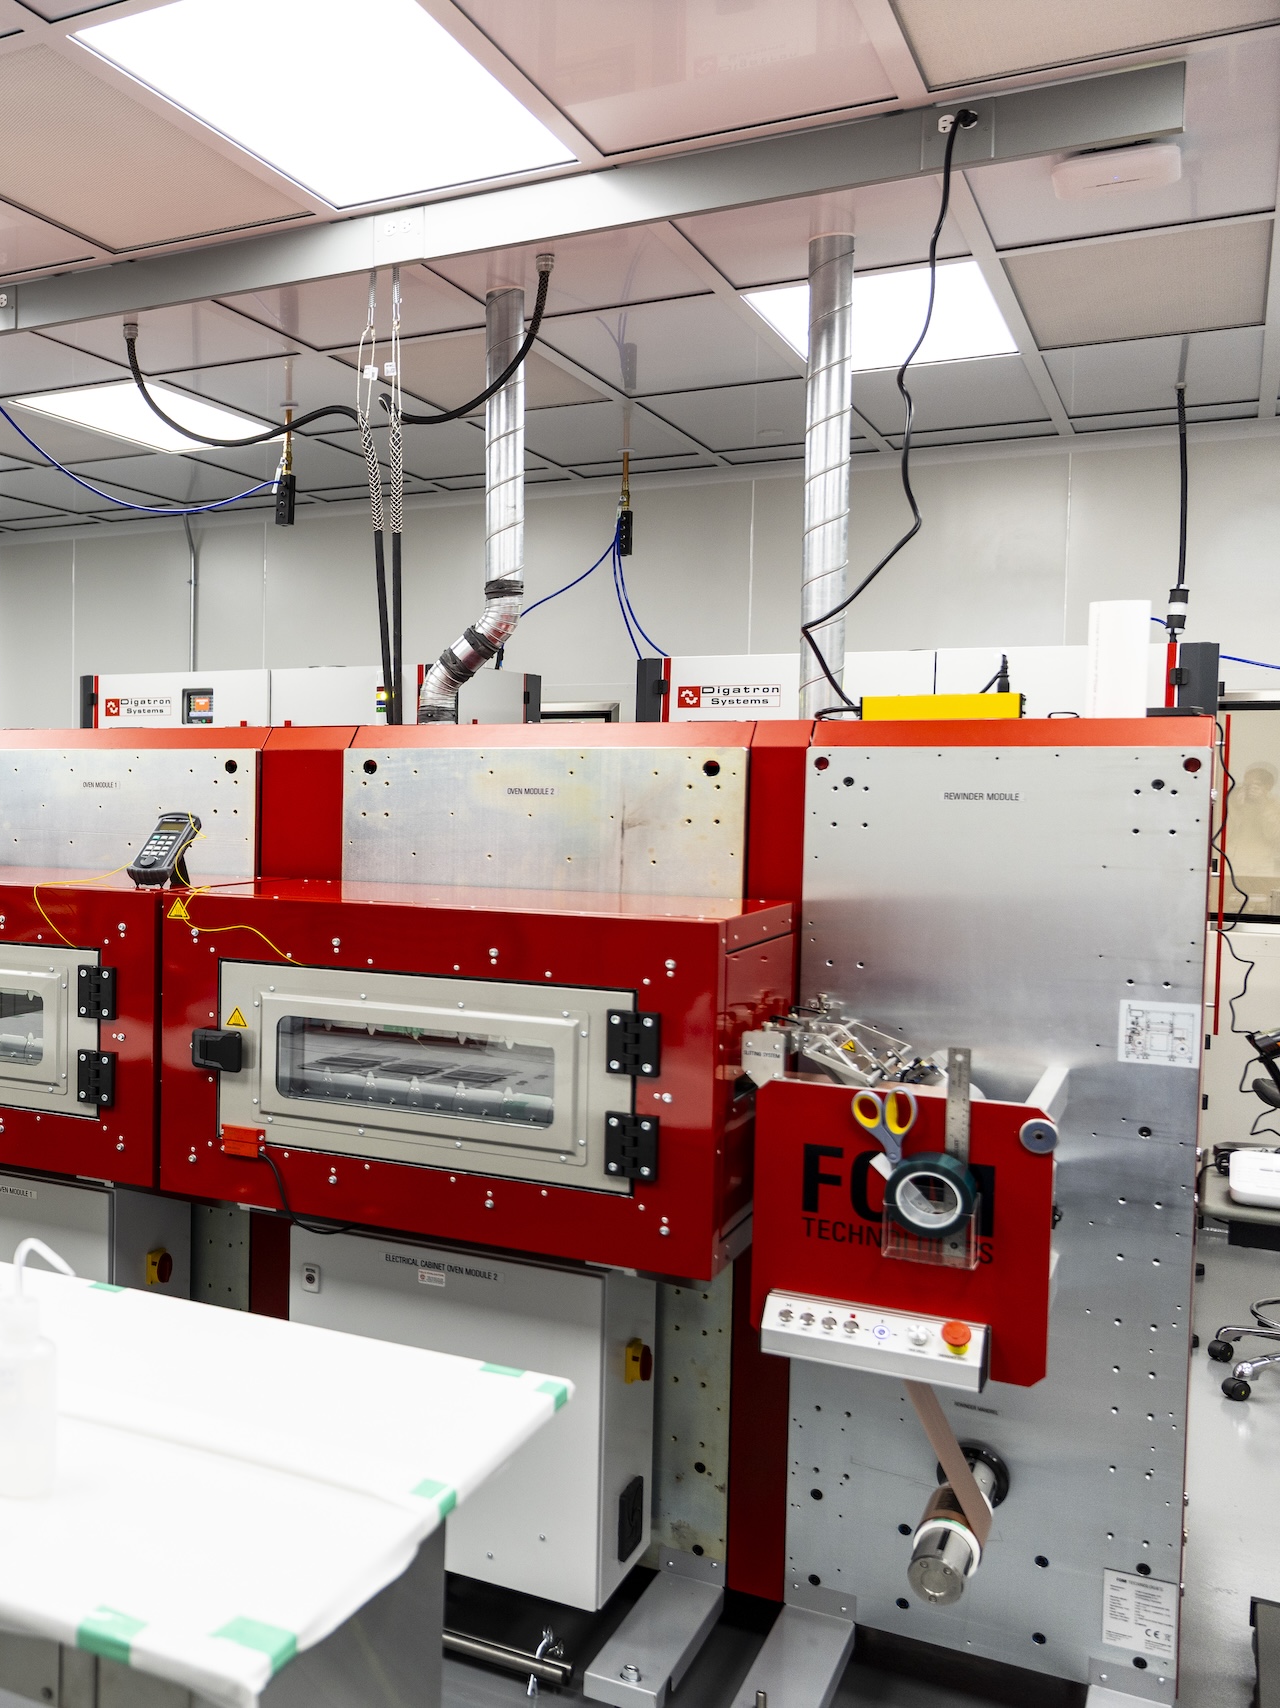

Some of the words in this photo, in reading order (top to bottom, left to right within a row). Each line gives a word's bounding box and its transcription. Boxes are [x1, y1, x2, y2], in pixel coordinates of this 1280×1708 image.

[701, 686, 780, 696] Digatron
[120, 698, 171, 707] Digatron
[711, 697, 769, 706] Systems
[126, 707, 164, 715] Systems
[95, 781, 114, 789] MODULE
[506, 787, 523, 795] OVEN
[523, 787, 549, 796] MODULE
[943, 792, 984, 800] REWINDER
[986, 792, 1020, 801] MODULE
[9, 1187, 29, 1197] MODULE
[802, 1143, 995, 1238] FO
[385, 1253, 419, 1267] ELECTRICAL
[420, 1259, 445, 1272] CABINET
[446, 1264, 464, 1275] OVEN
[464, 1267, 492, 1280] MODULE
